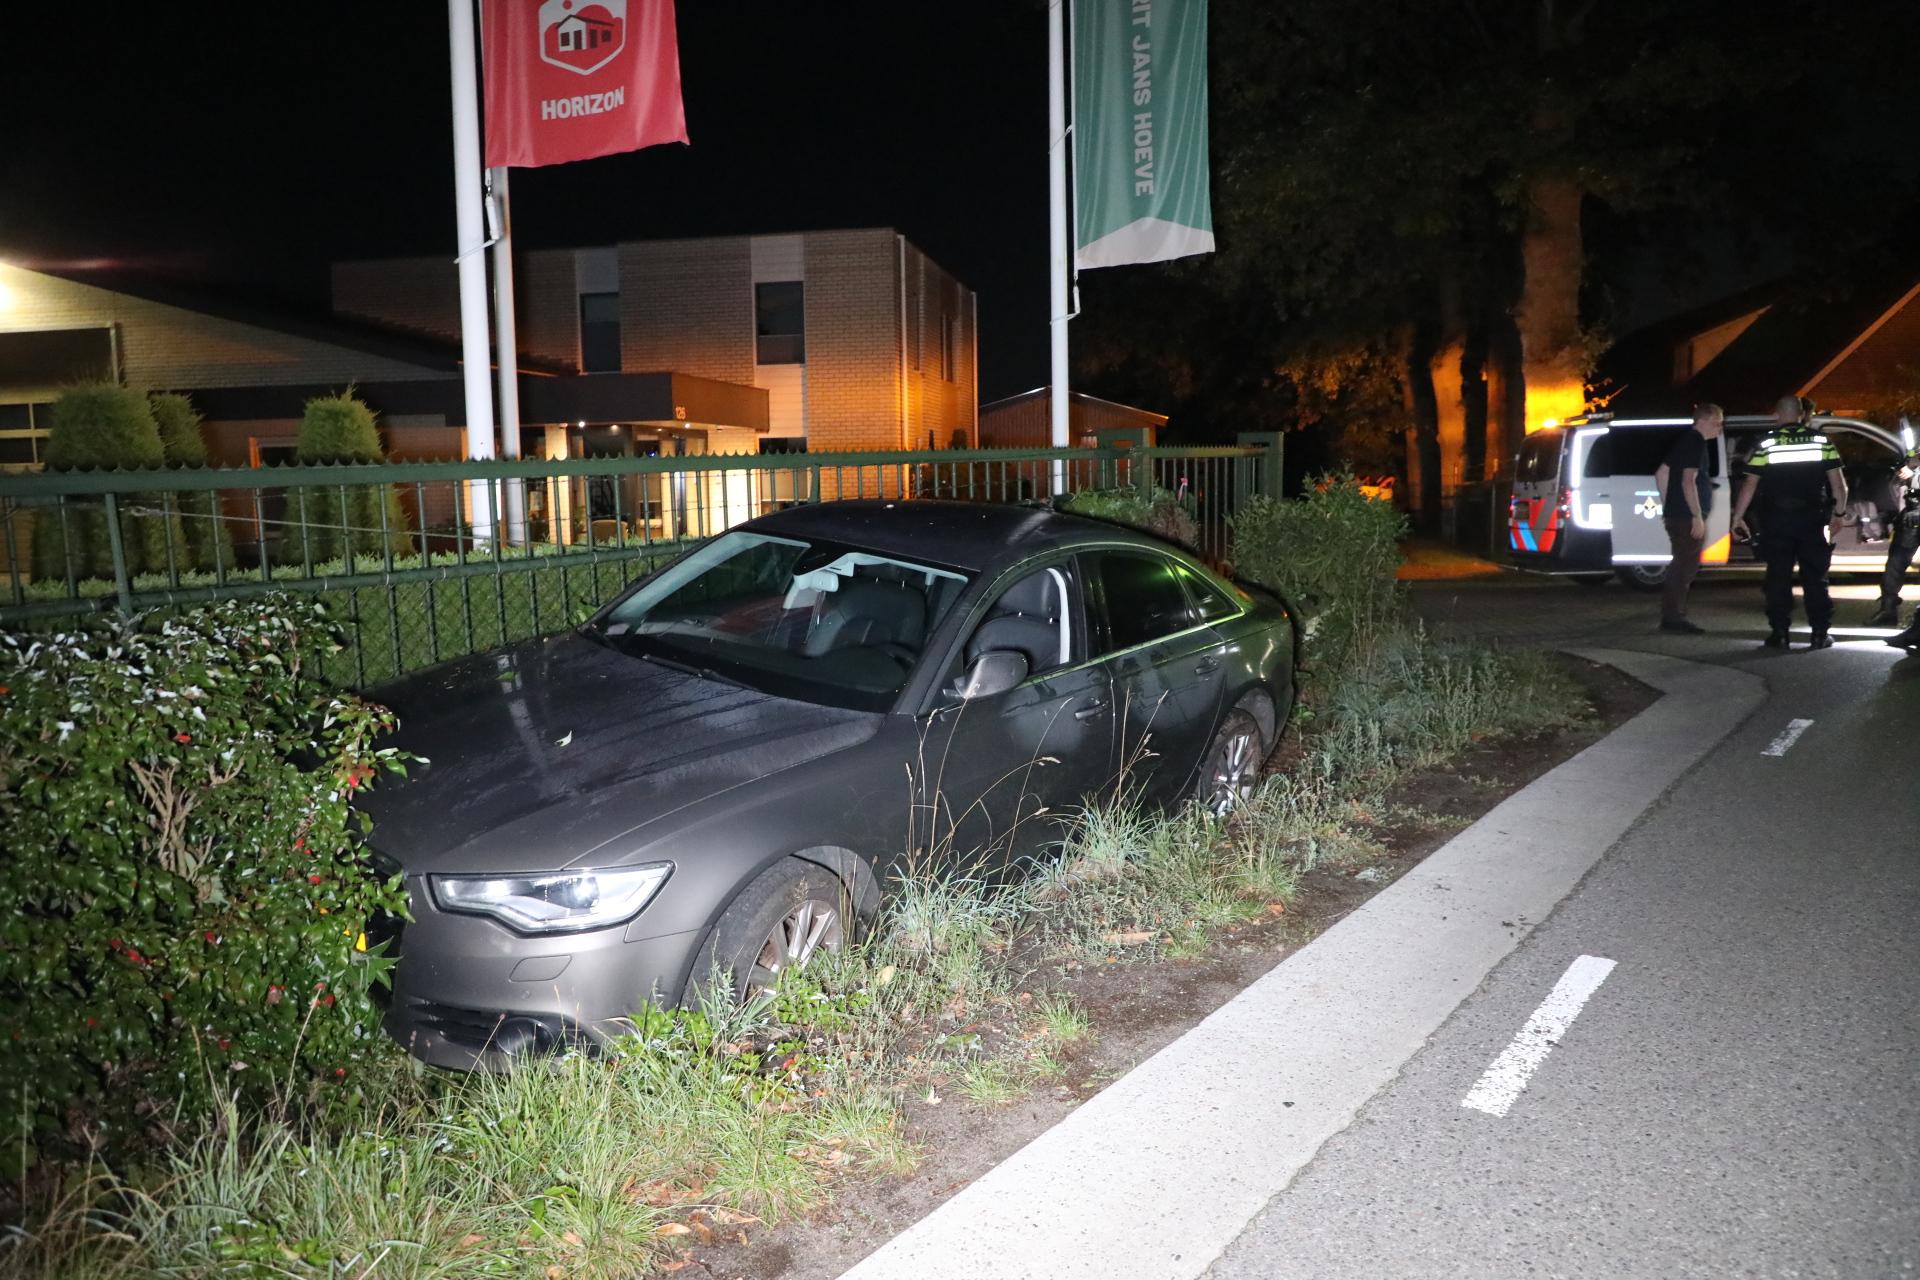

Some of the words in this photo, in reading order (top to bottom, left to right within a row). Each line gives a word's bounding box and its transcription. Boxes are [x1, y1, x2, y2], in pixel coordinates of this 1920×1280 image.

[542, 86, 624, 120] HORIZON
[1132, 35, 1151, 106] JANS
[1133, 112, 1154, 197] HOEVE
